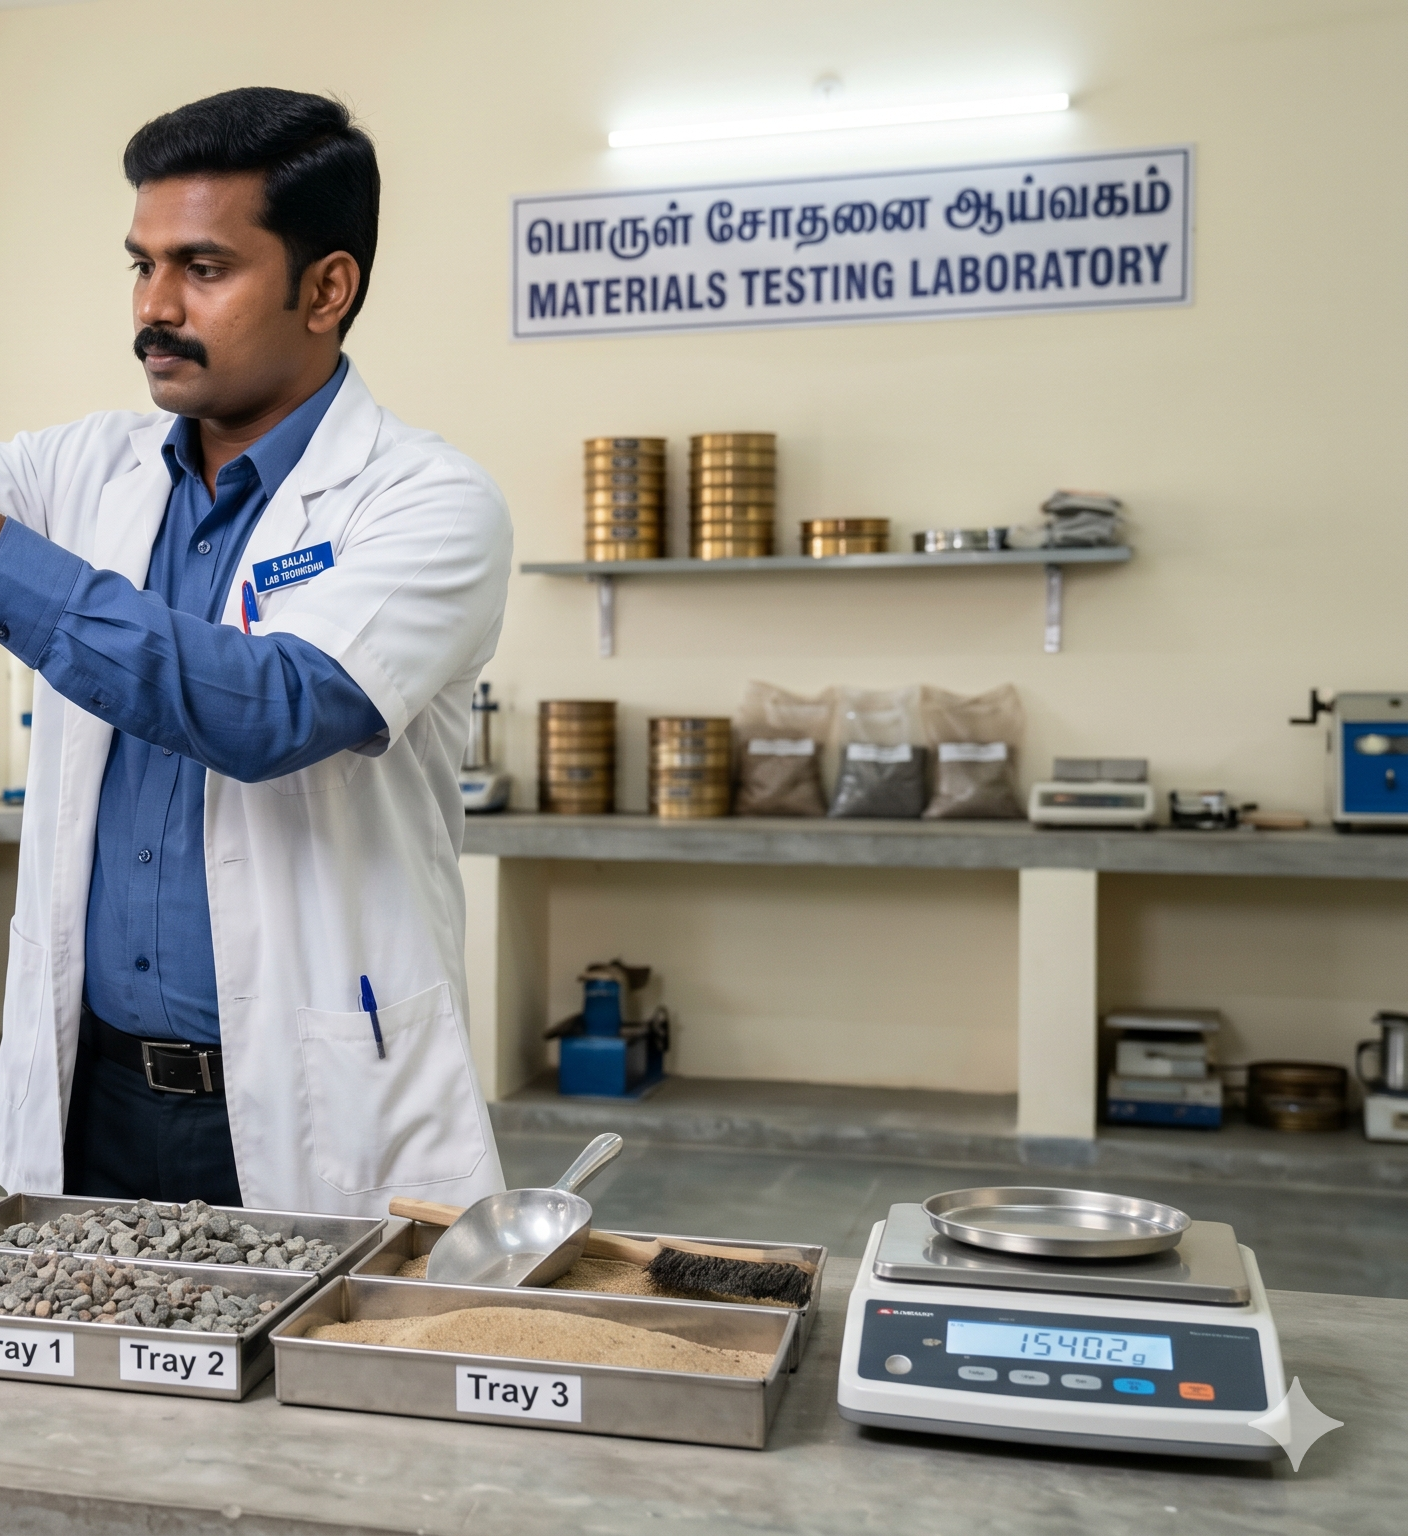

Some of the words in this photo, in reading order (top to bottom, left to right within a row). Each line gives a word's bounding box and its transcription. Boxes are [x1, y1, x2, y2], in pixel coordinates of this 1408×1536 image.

[527, 200, 694, 260] பொருள்
[706, 198, 932, 252] சோதனை
[945, 164, 1172, 236] ஆய்வகம்
[528, 270, 728, 320] MATERIALS
[741, 260, 895, 308] TESTING
[910, 242, 1171, 298] LABORATORY
[281, 551, 313, 569] BALAJI
[264, 575, 280, 586] LAB
[49, 1338, 61, 1364] 1
[129, 1343, 196, 1380] Tray
[207, 1350, 224, 1376] 2
[467, 1373, 539, 1411] Tray
[551, 1381, 569, 1407] 3
